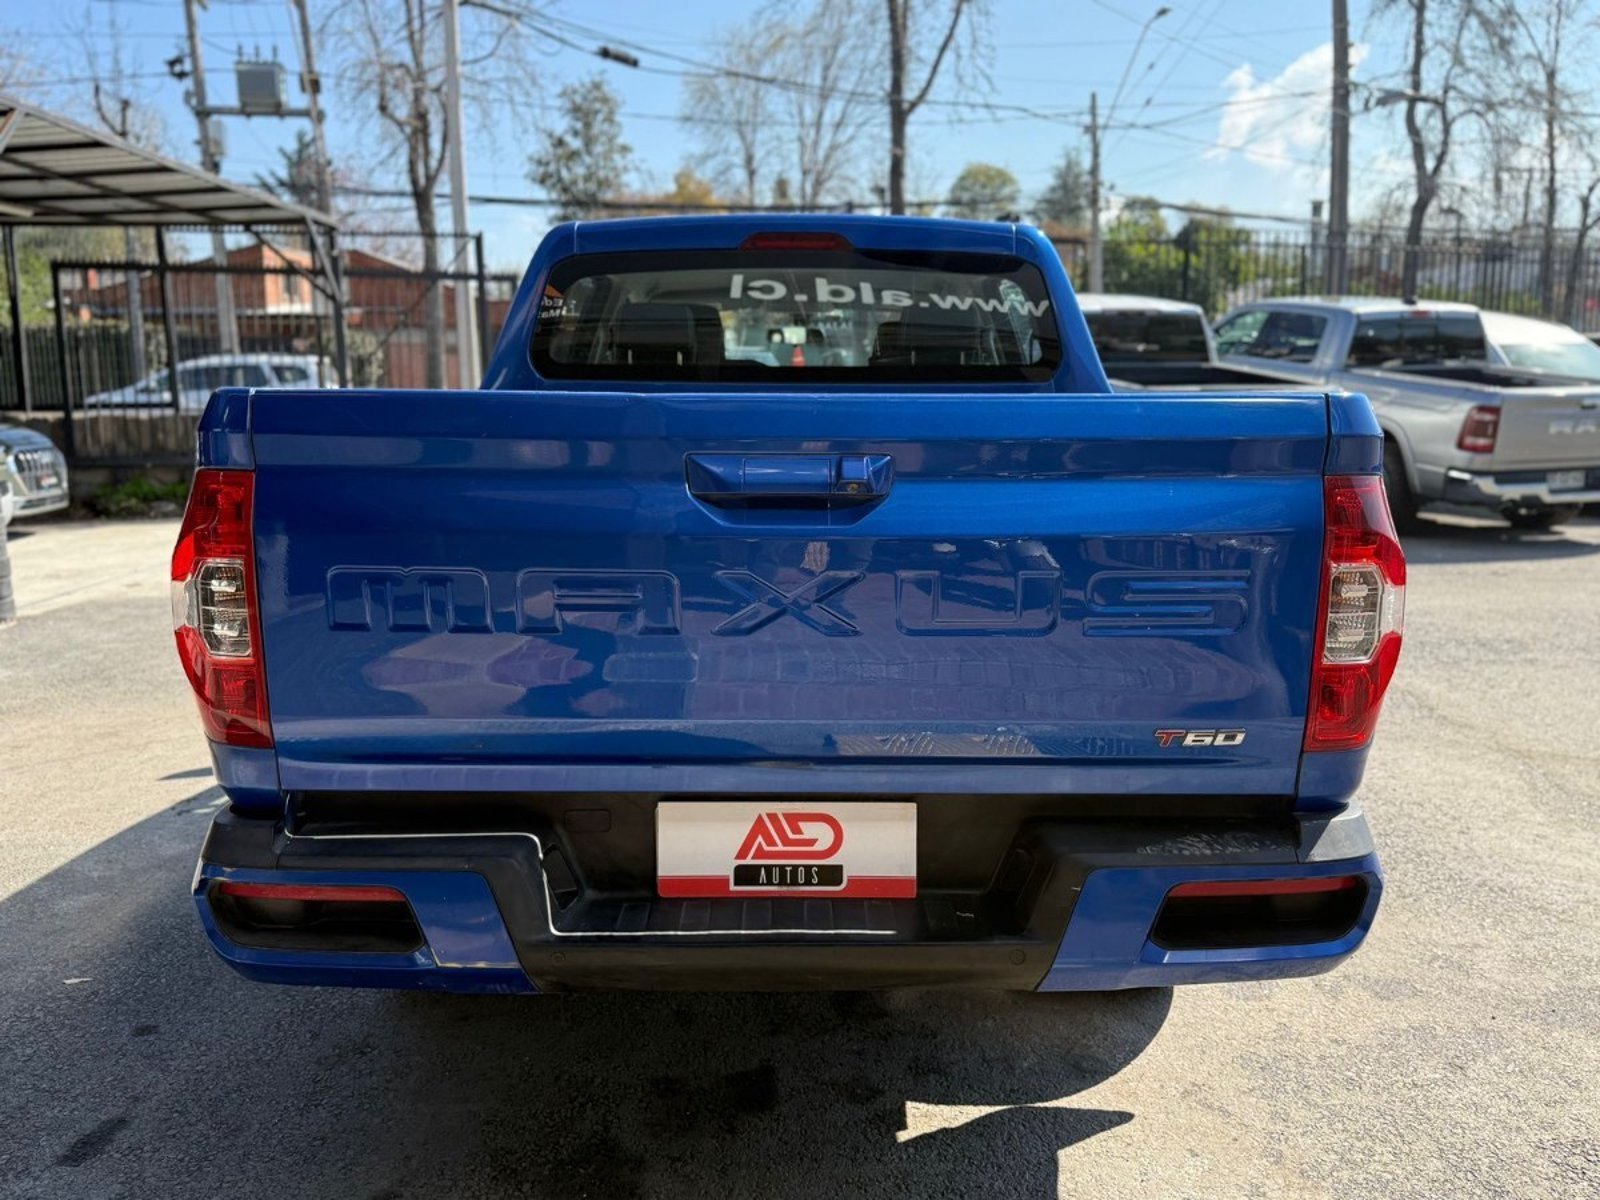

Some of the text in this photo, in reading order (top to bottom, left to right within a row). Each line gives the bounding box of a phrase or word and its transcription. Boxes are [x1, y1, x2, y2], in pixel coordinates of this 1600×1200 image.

[1548, 420, 1600, 434] RA
[1155, 729, 1246, 748] T60
[759, 866, 819, 884] AUTOS
